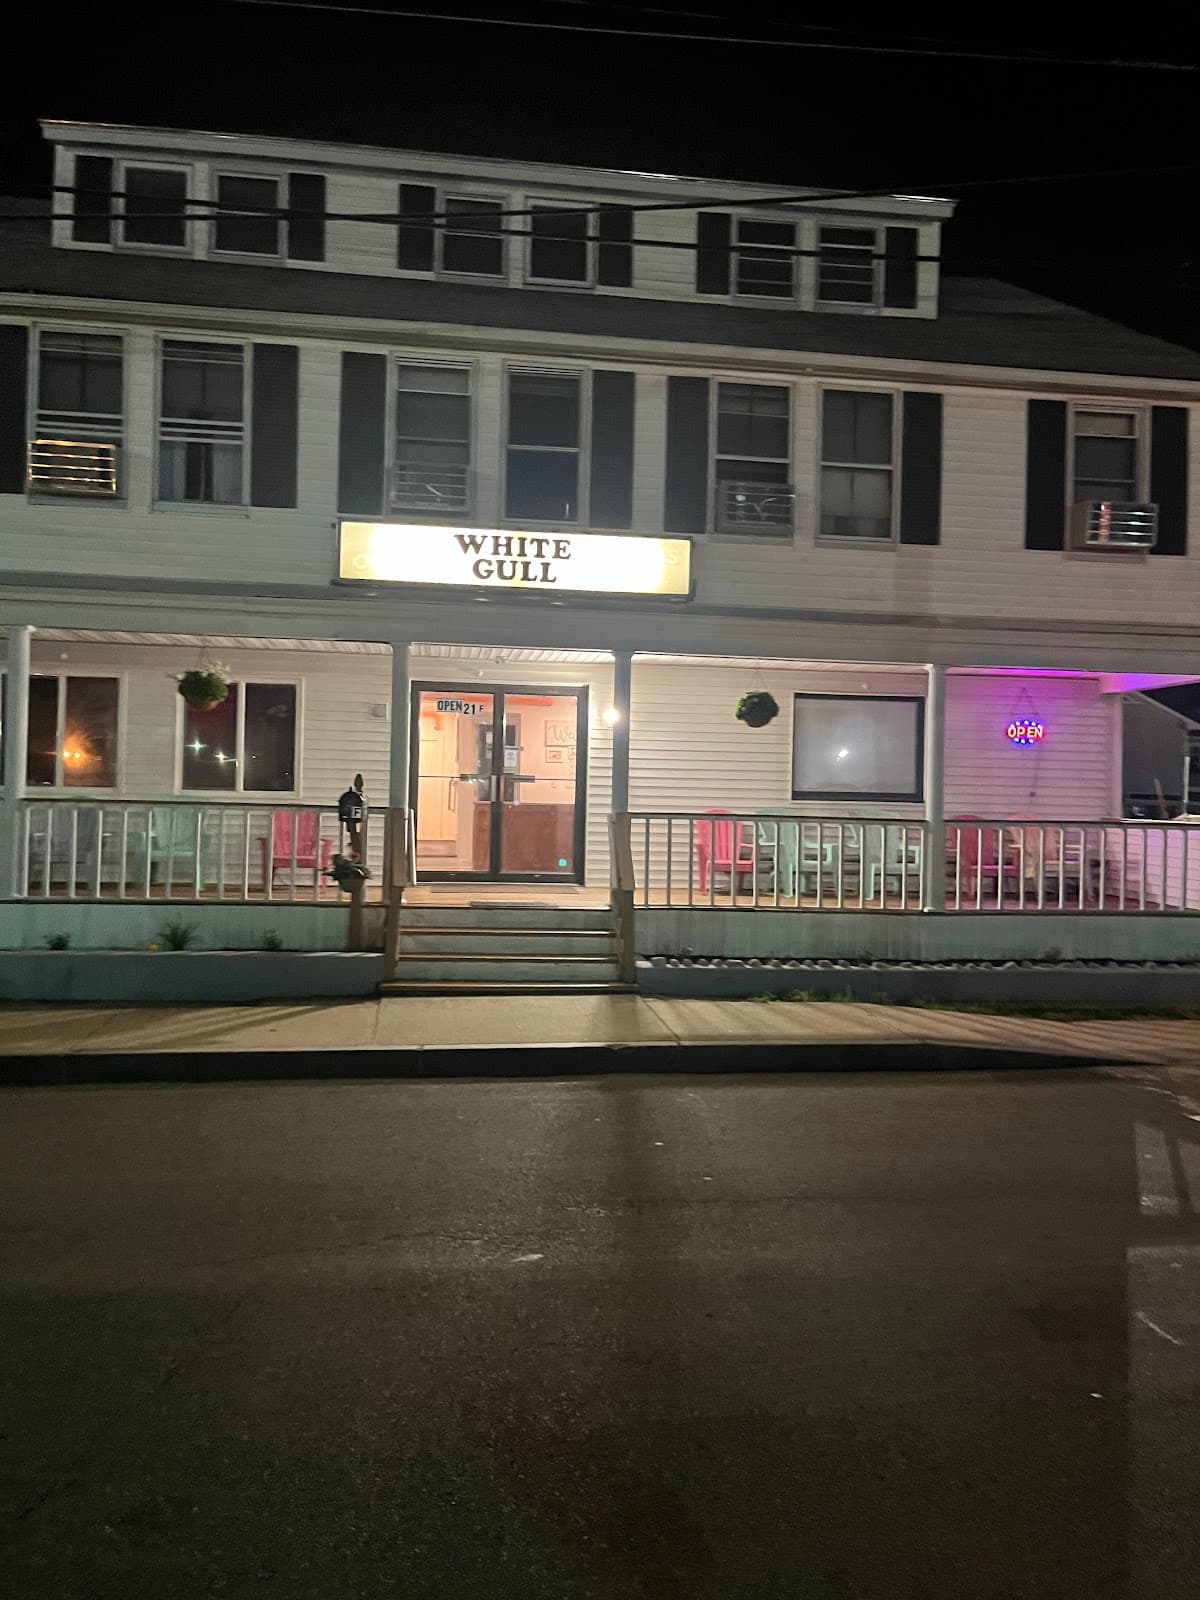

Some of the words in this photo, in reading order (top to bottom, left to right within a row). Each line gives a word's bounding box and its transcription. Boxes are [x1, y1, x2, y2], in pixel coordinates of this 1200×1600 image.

[454, 534, 571, 559] WHITE
[472, 558, 557, 582] GULL
[437, 700, 462, 711] OPEN
[463, 703, 476, 715] 21
[1007, 726, 1043, 738] OPEN
